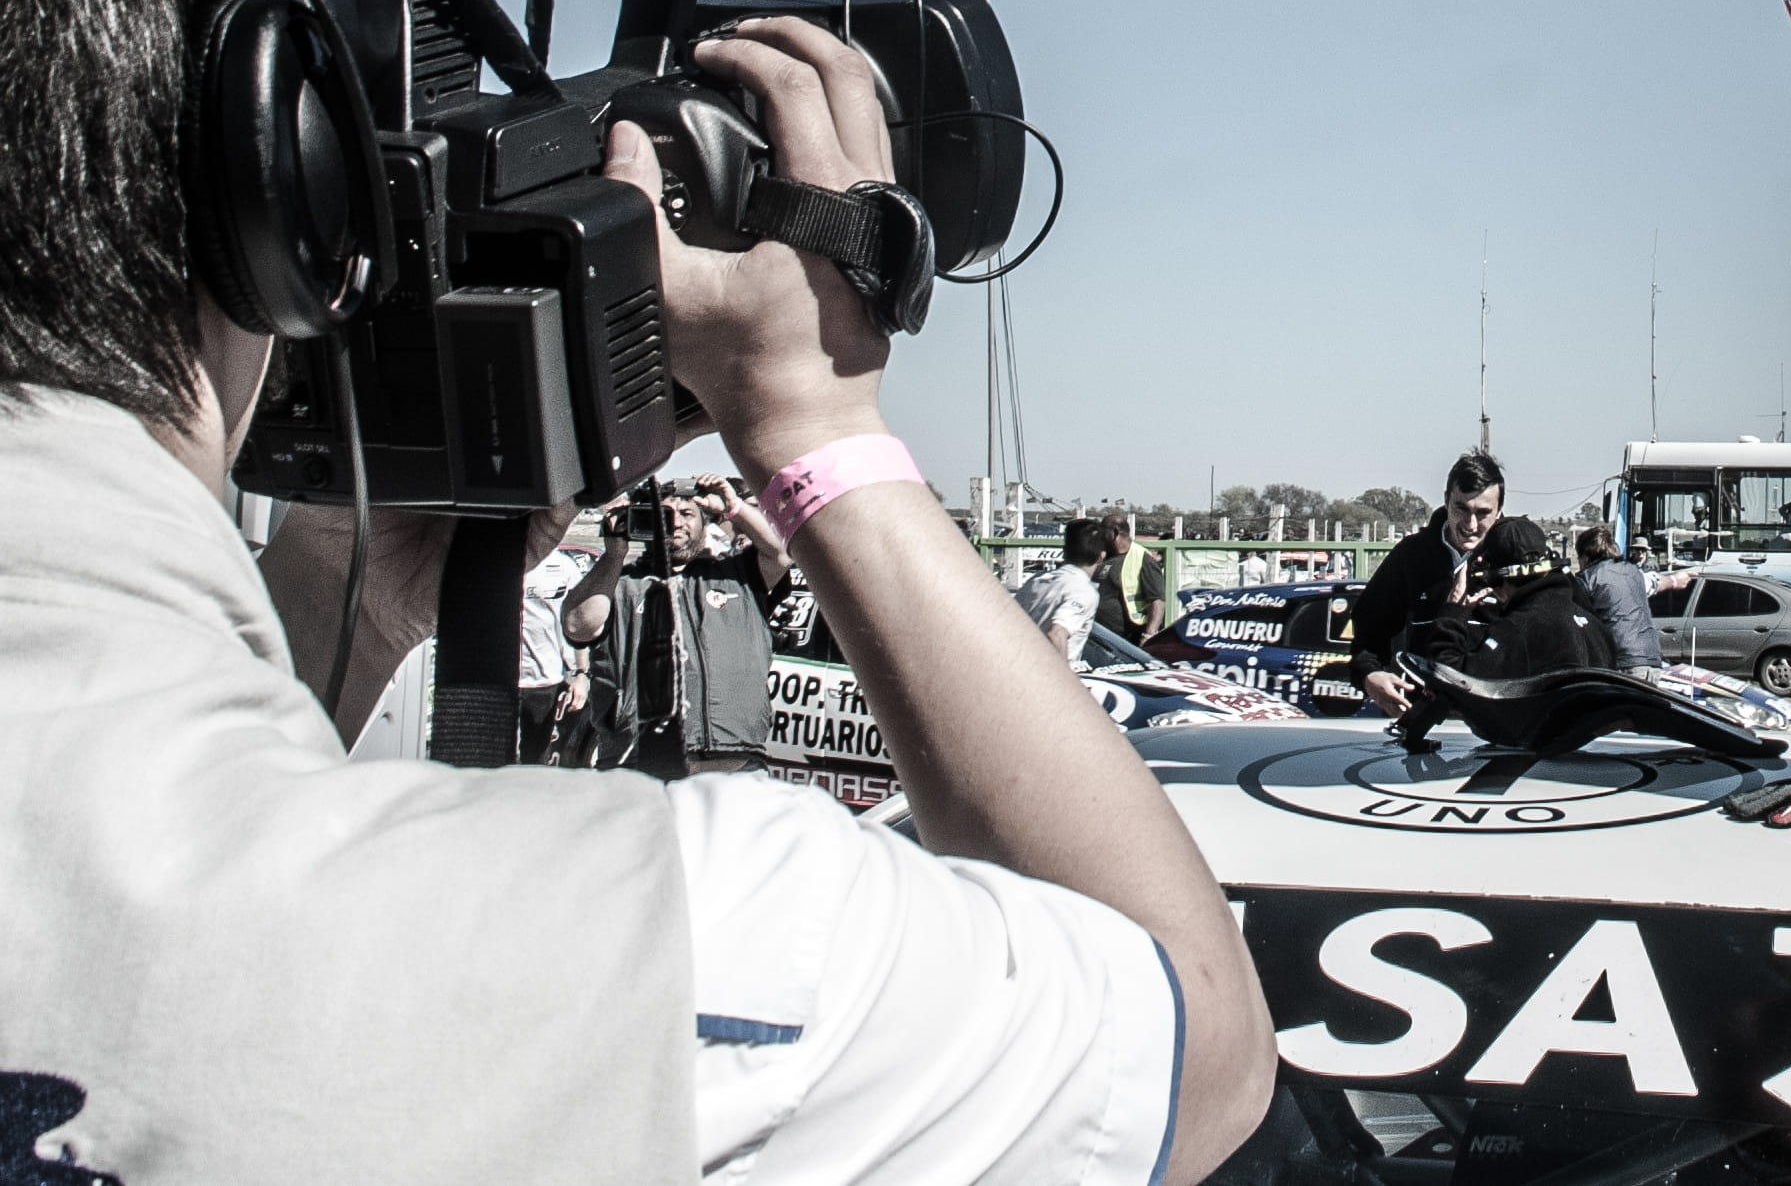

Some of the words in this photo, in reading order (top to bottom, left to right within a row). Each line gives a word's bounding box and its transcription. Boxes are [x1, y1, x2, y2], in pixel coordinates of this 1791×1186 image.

[1185, 618, 1283, 643] BONUFRU
[771, 710, 892, 760] RTUARIO
[1359, 799, 1566, 825] UNO
[1228, 901, 1699, 1097] SA
